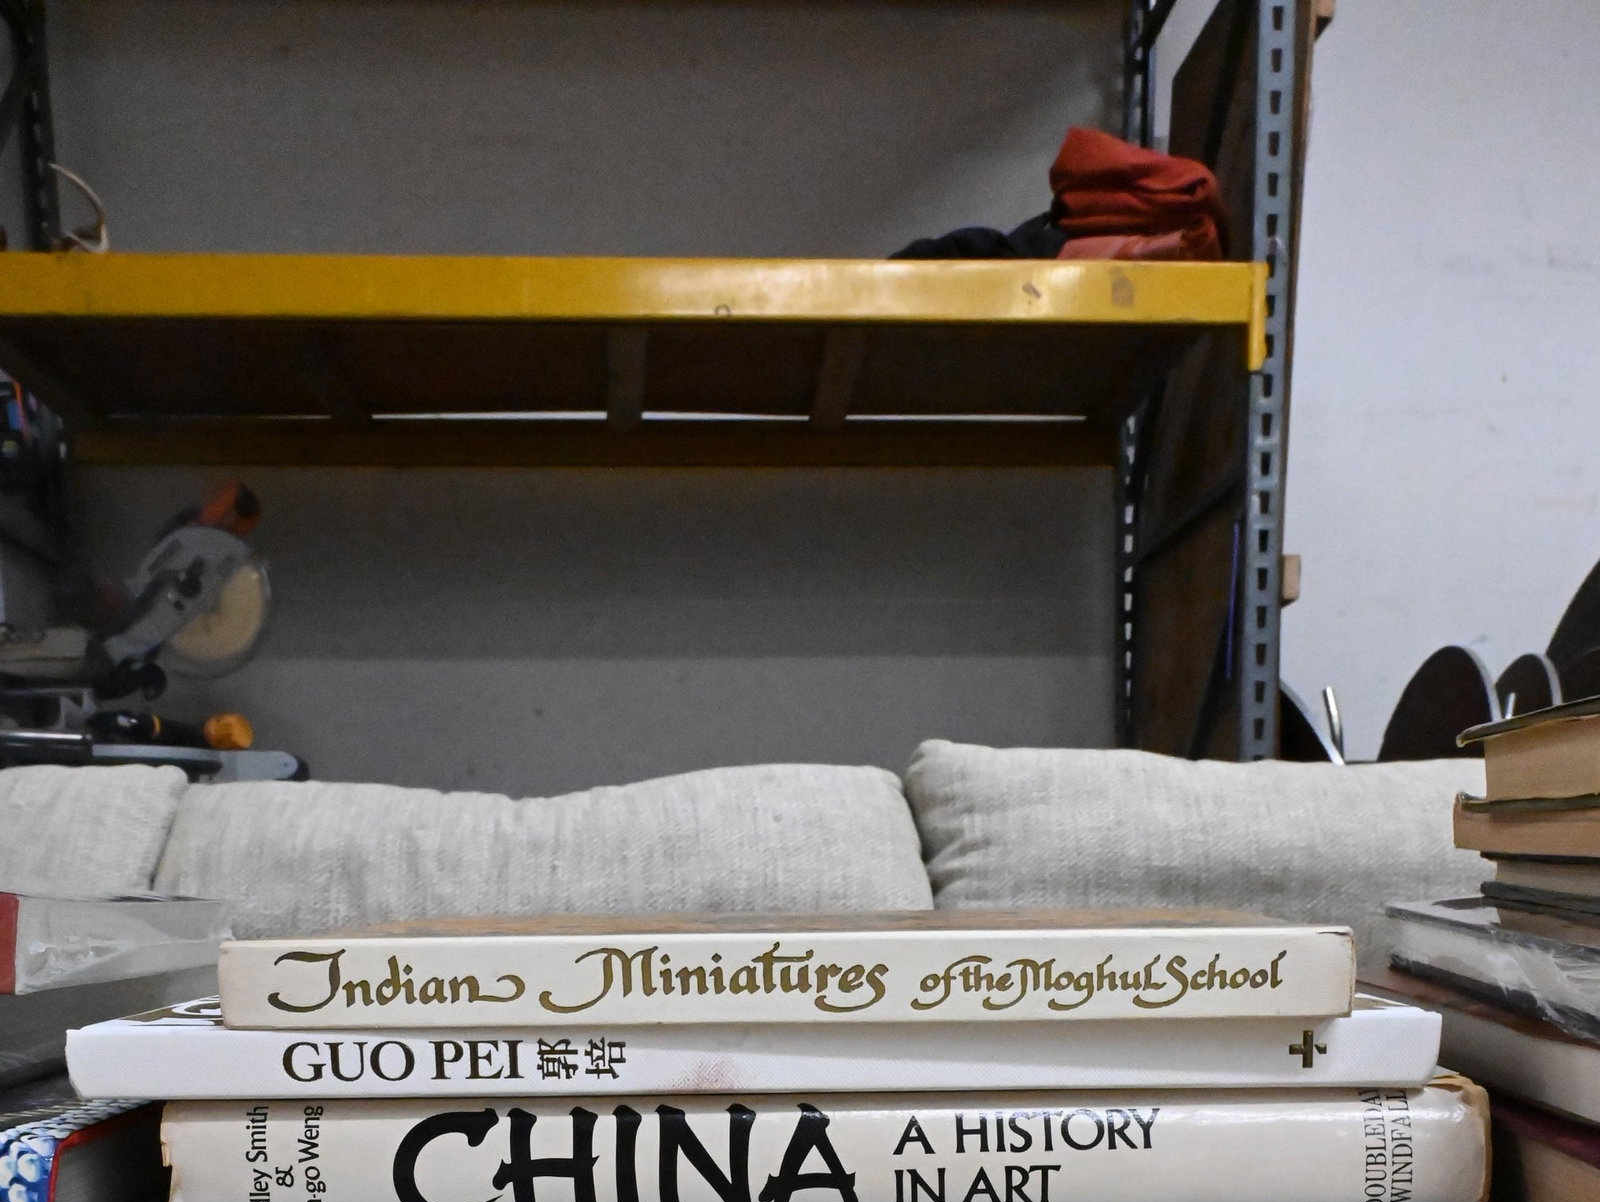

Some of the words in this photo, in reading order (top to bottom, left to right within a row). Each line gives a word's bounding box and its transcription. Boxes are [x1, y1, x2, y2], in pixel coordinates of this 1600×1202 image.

[268, 948, 525, 1013] Indian
[539, 941, 889, 1013] Miniatures
[959, 963, 1013, 992] the
[982, 953, 1167, 1011] Moghul
[1132, 950, 1287, 1009] School
[282, 1041, 416, 1083] GUO
[430, 1038, 524, 1080] PEI
[245, 1106, 269, 1163] Smith
[297, 1106, 324, 1163] Weng
[893, 1115, 935, 1156] A
[956, 1107, 1160, 1153] HISTORY
[275, 1165, 295, 1188] &
